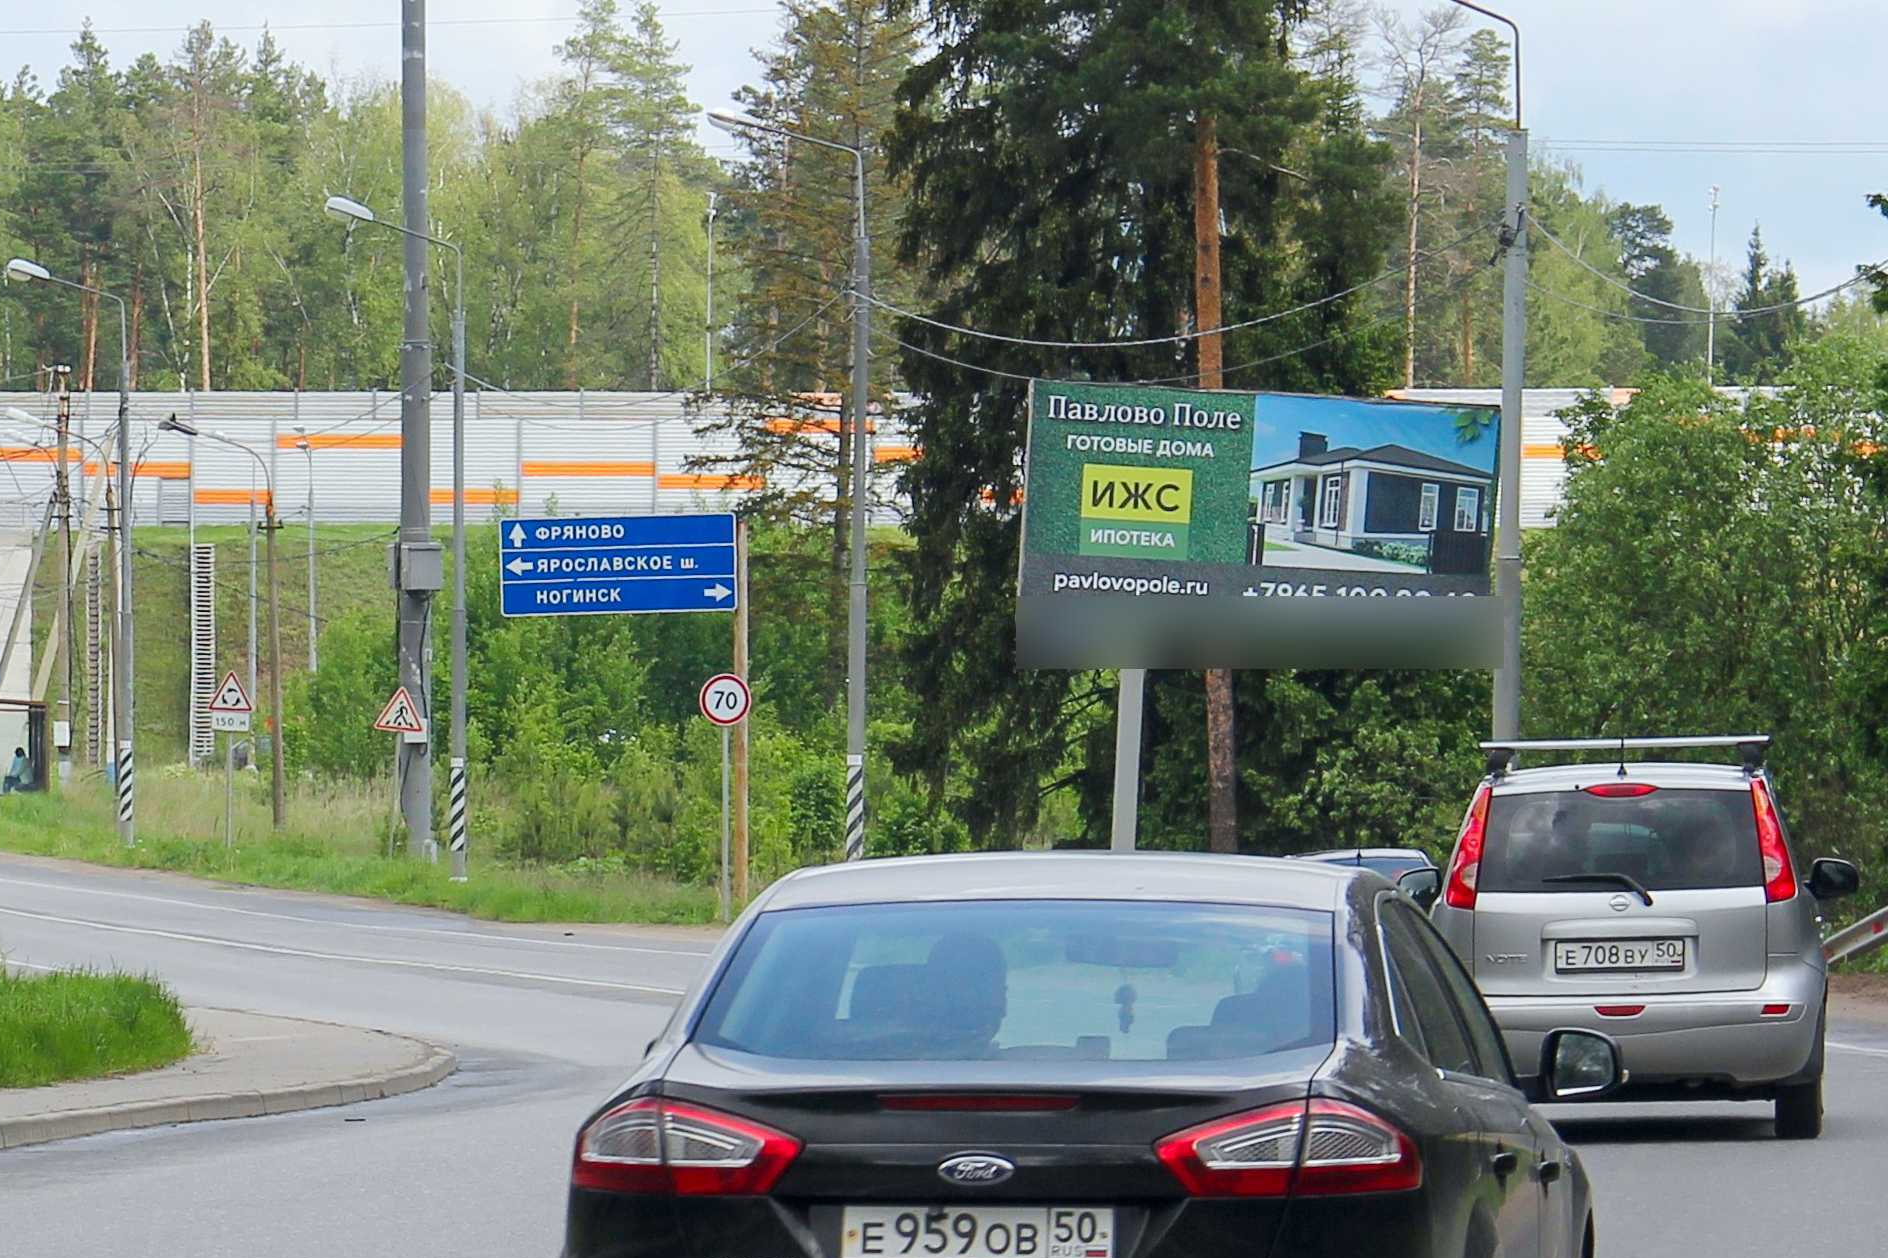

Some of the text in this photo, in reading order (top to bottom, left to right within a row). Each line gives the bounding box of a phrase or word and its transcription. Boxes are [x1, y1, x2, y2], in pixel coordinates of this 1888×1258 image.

[1048, 395, 1241, 429] Павлово Поле
[1067, 434, 1215, 458] ГОТОВЫЕ ДОМА
[1092, 480, 1180, 512] ИЖС
[535, 524, 625, 540] ФРЯНОВО
[1090, 528, 1176, 548] ИПОТЕКА
[536, 555, 699, 573] ЯРОСЛАВСКОЕ ш.
[1053, 571, 1209, 596] pavlovopole.ru
[536, 588, 622, 605] НОГИНСК
[714, 691, 738, 710] 70
[215, 717, 235, 727] 150
[1656, 942, 1677, 958] 50
[954, 1161, 998, 1180] Ford
[1054, 1211, 1097, 1244] 50
[1051, 1245, 1083, 1257] RUS
